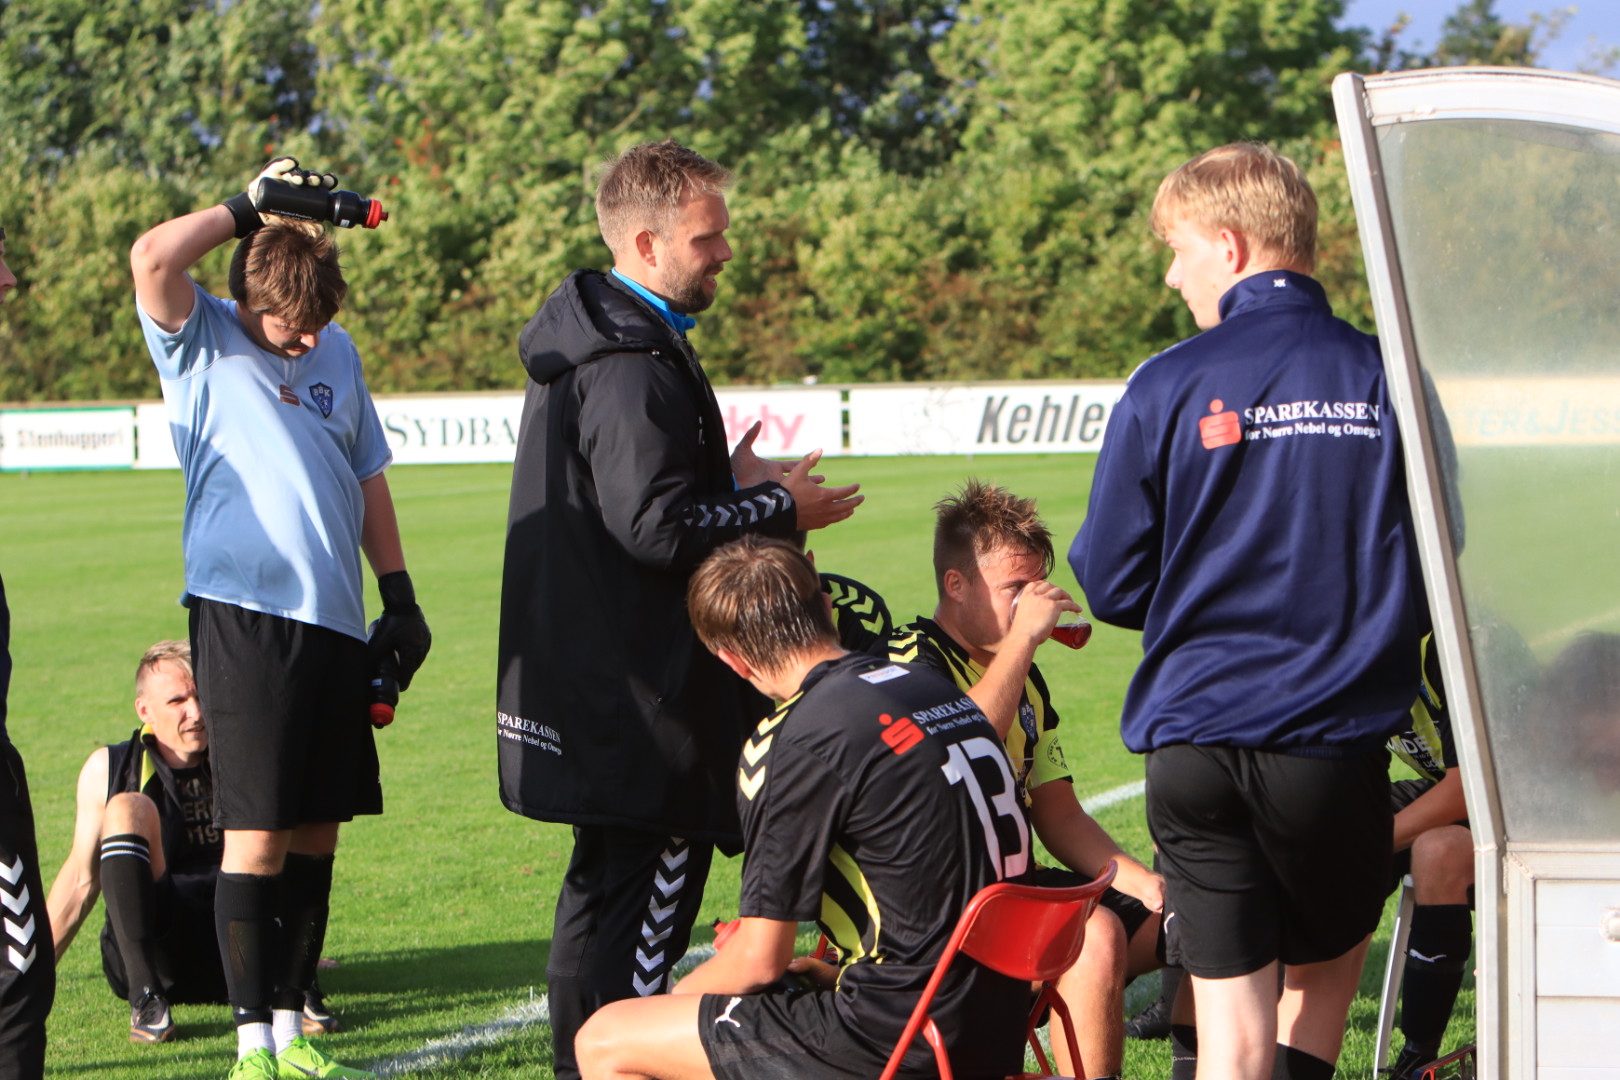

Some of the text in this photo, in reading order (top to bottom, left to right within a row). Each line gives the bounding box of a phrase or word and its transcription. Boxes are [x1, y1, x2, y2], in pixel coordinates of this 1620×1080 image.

[976, 394, 1105, 443] Kehle
[1244, 400, 1380, 425] SPAREKASSEN
[1294, 422, 1326, 435] Nebel
[1327, 425, 1342, 438] og
[1343, 422, 1381, 439] Omegn
[498, 712, 561, 742] SPAREKASSEN
[941, 736, 1029, 882] 13
